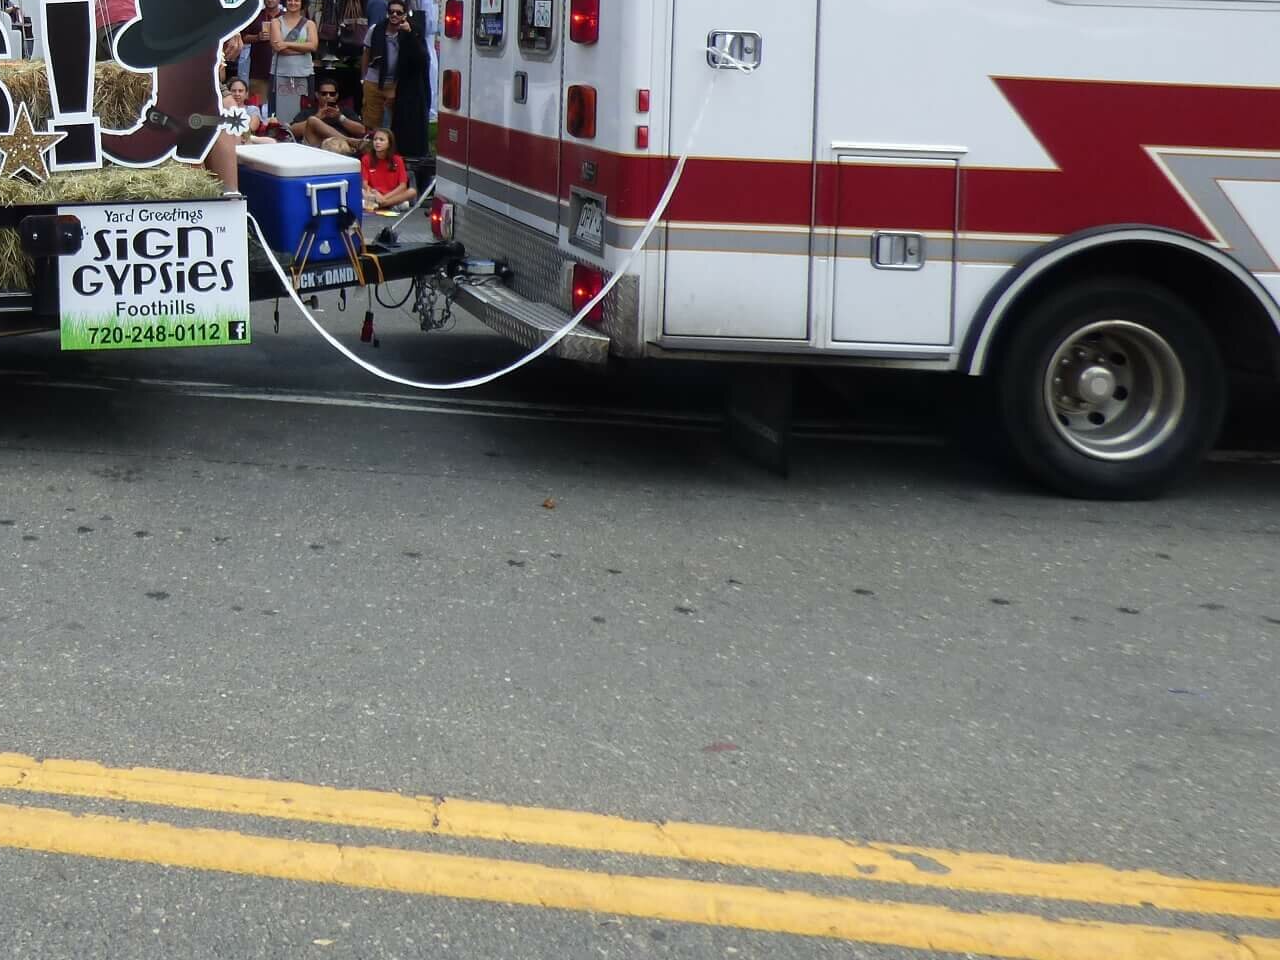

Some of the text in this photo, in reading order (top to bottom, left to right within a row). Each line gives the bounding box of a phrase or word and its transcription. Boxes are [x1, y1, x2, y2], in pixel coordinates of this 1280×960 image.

[104, 208, 203, 224] Yard Greetings
[116, 299, 196, 317] Foothills
[88, 323, 220, 345] 720-248-0112
